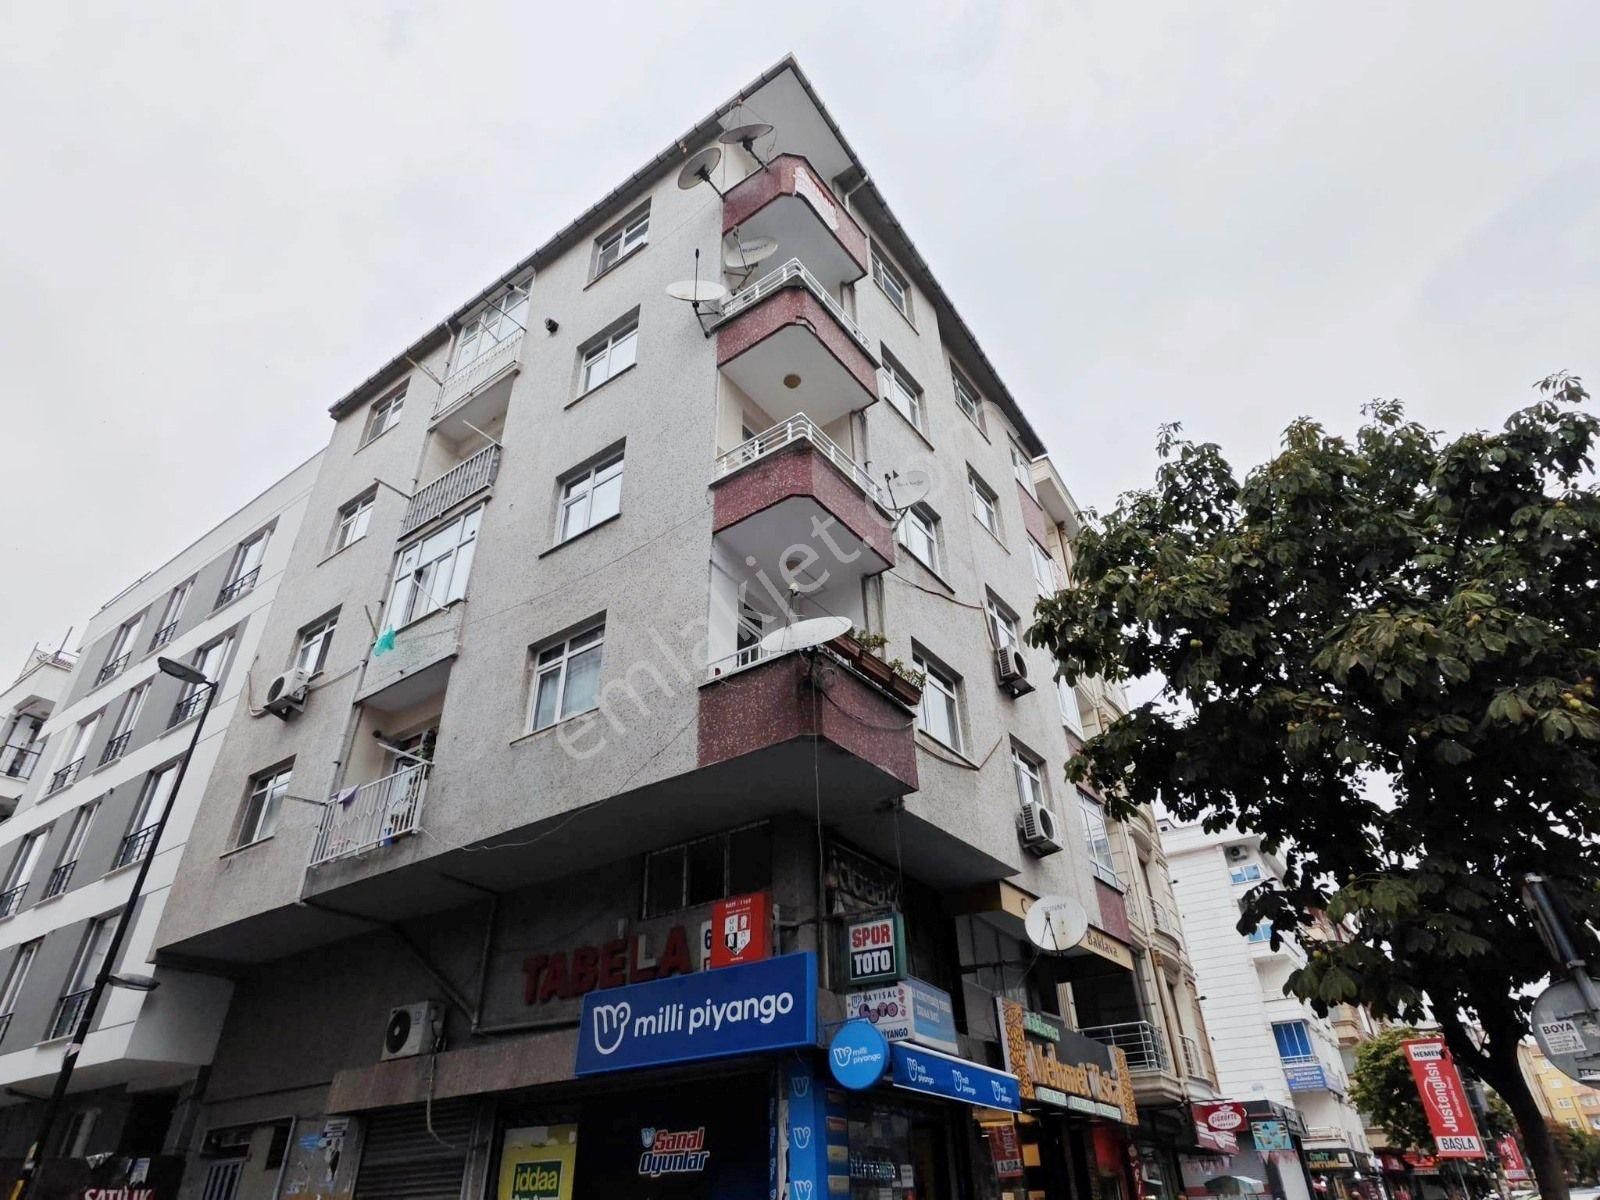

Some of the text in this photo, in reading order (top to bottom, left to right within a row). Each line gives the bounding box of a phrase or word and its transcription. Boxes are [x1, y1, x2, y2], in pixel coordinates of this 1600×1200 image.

[852, 924, 890, 948] SPOR
[523, 926, 694, 1006] TABELA
[854, 949, 891, 975] TOTO
[634, 992, 794, 1037] milli piyango
[859, 1002, 898, 1023] LOTO
[1542, 1022, 1574, 1035] BOYA
[853, 1047, 868, 1056] milli
[853, 1053, 881, 1064] piyango
[1413, 1050, 1441, 1058] HEMEN
[918, 1066, 926, 1074] milli
[918, 1075, 934, 1086] piyango
[1424, 1062, 1458, 1132] Justenglish
[655, 1127, 705, 1150] Sanal
[639, 1150, 710, 1177] Oyunlar
[515, 1166, 558, 1191] iddaa
